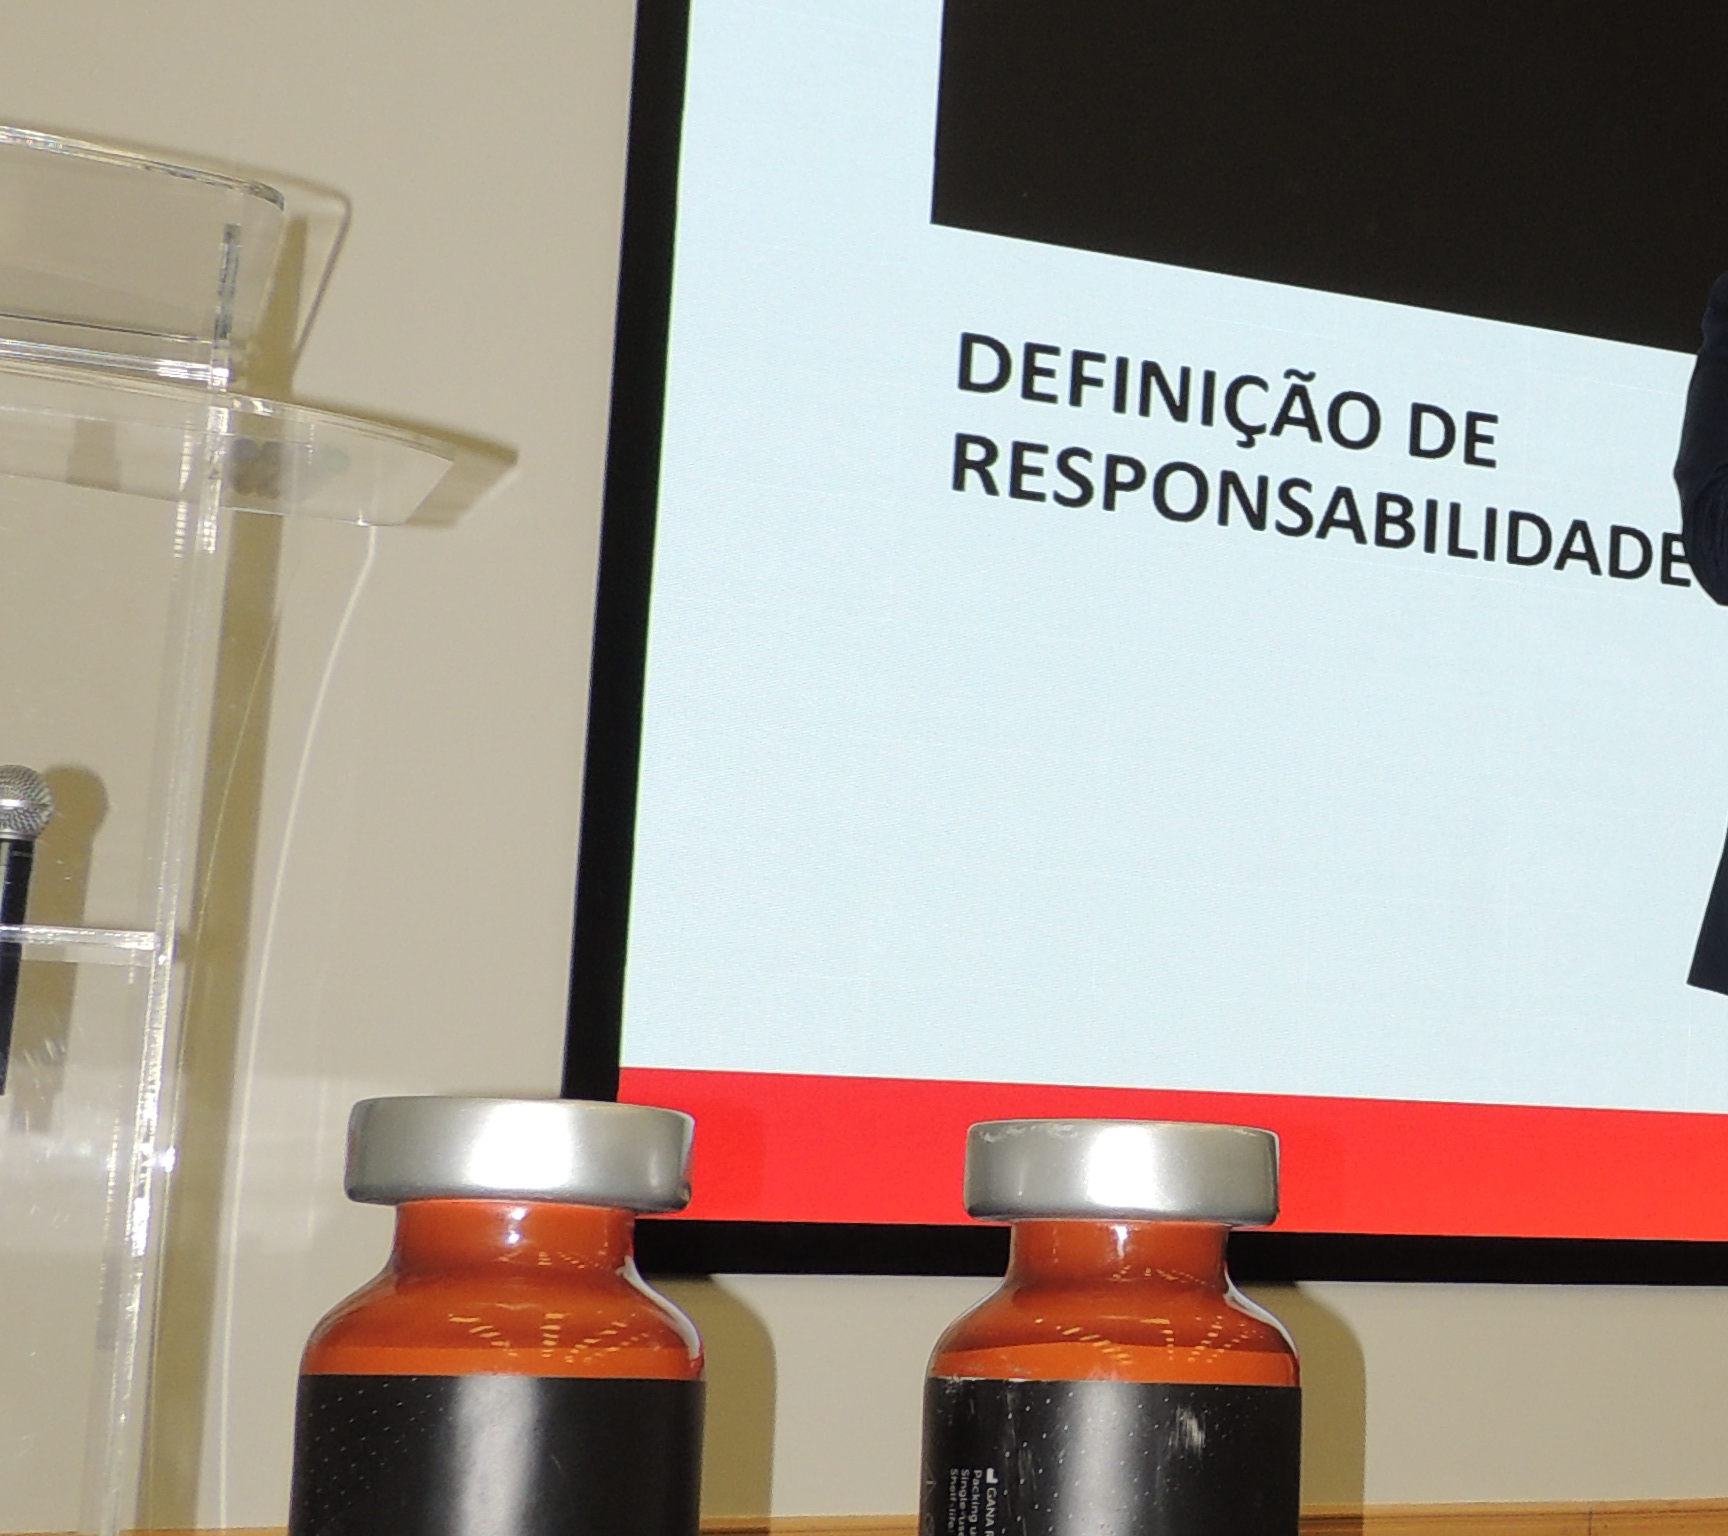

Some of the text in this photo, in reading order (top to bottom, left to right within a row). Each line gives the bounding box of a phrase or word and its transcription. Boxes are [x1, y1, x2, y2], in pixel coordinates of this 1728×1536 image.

[955, 331, 1499, 469] DEFINIÇÃO DE
[951, 430, 1692, 588] RESPONSABILIDADE
[969, 1470, 982, 1522] Packing
[985, 1488, 996, 1527] GANA
